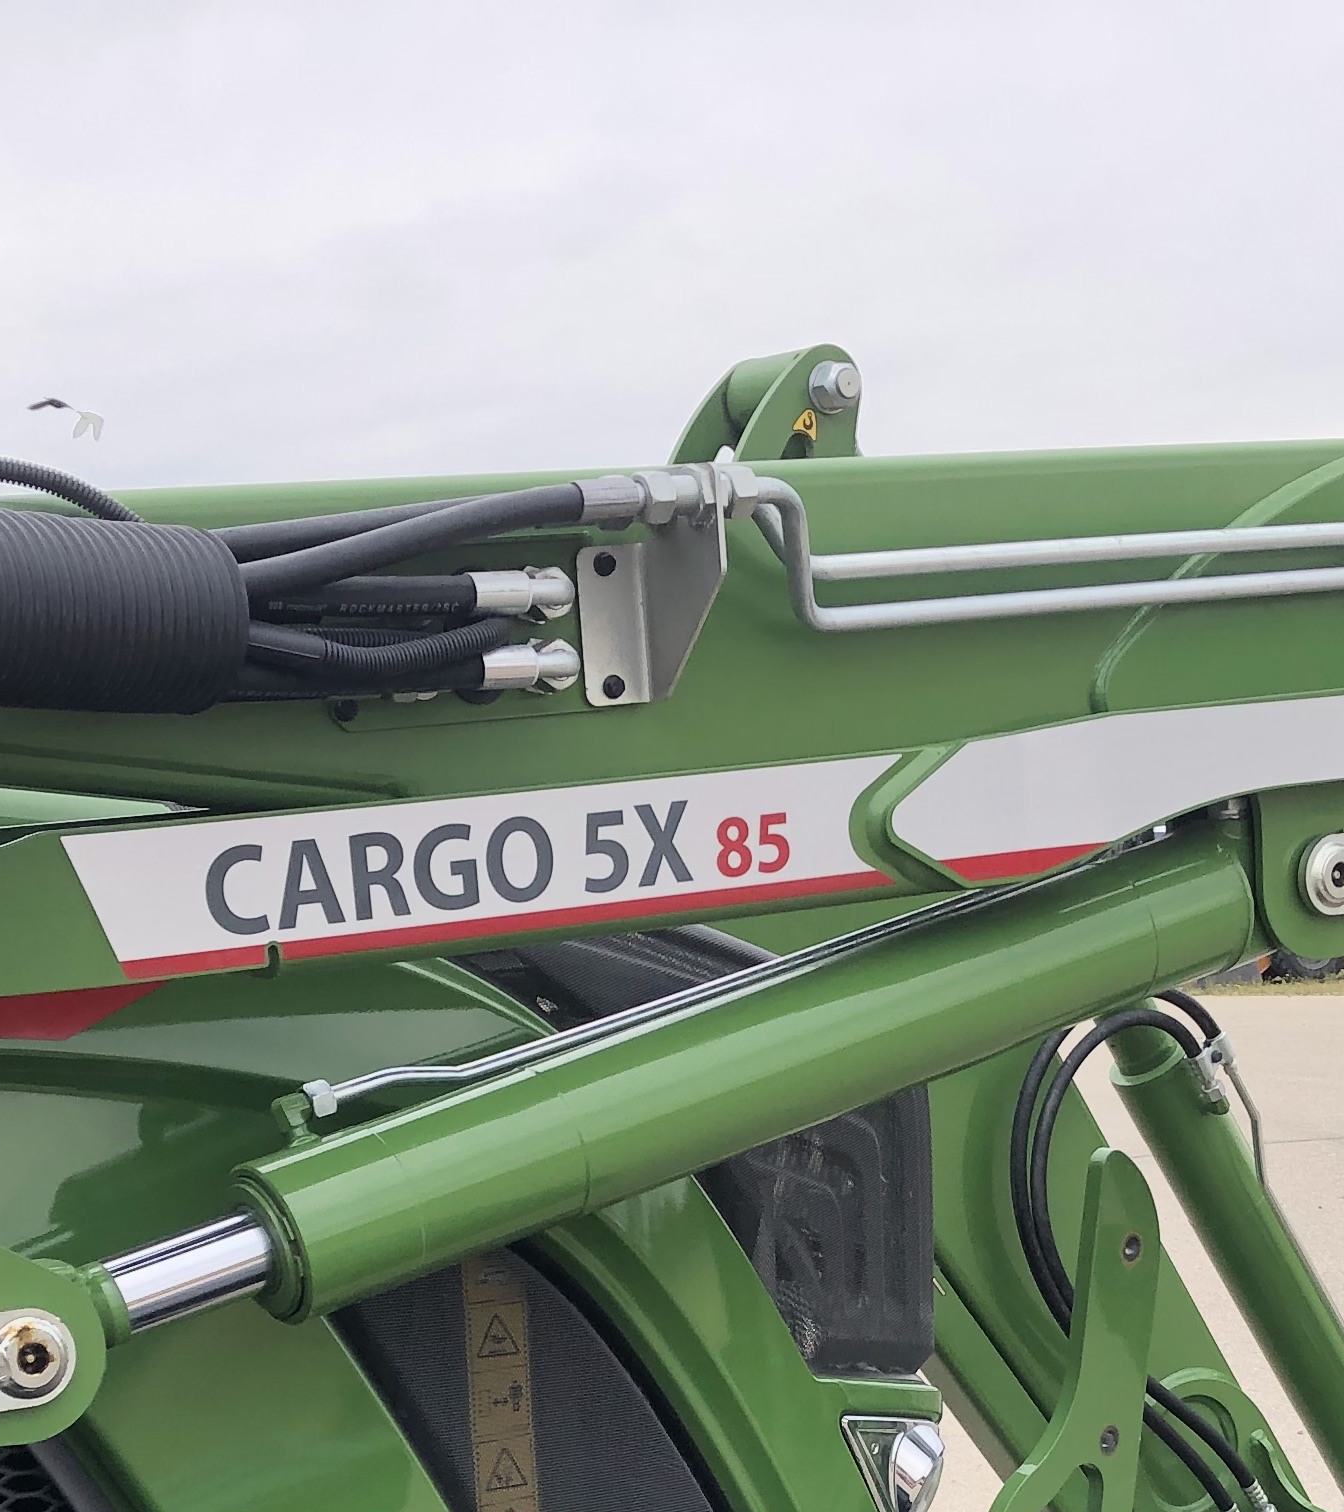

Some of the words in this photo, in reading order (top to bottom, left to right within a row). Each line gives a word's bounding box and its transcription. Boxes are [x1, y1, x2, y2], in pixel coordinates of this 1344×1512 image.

[204, 814, 556, 936] CARGO
[584, 799, 694, 894] 5X
[716, 811, 791, 878] 85
